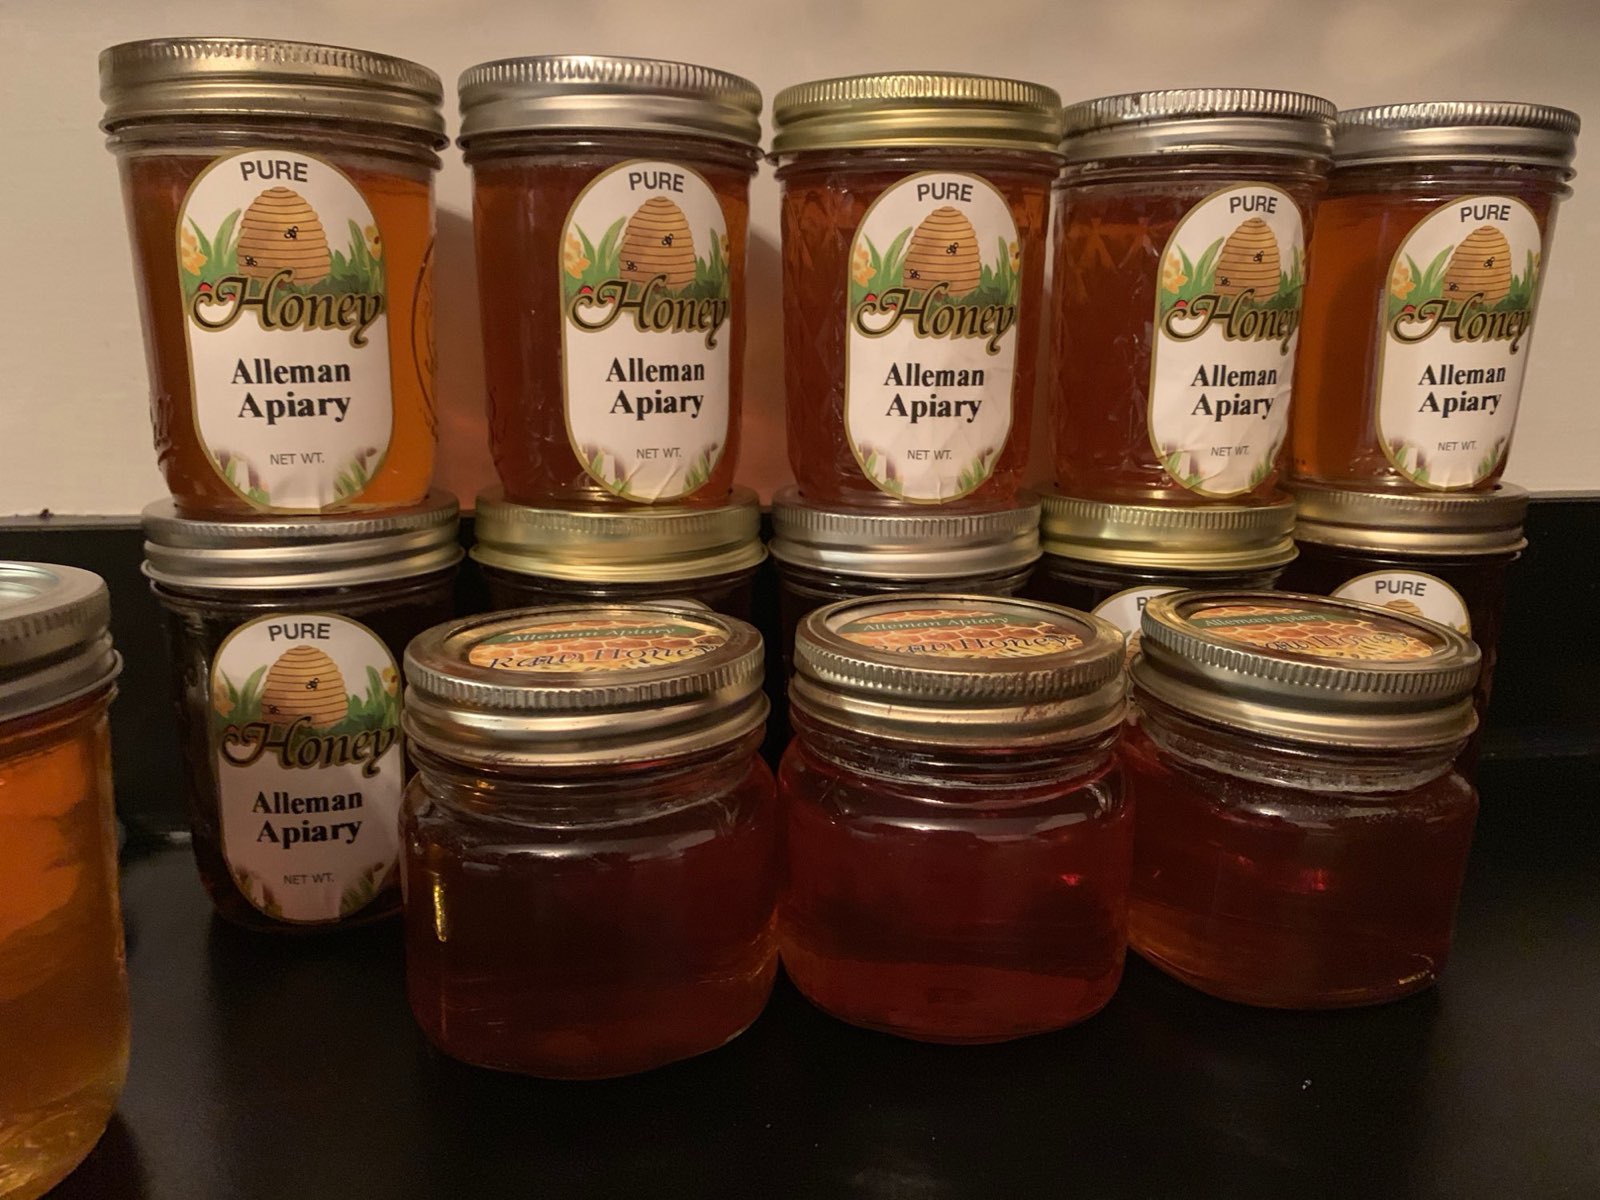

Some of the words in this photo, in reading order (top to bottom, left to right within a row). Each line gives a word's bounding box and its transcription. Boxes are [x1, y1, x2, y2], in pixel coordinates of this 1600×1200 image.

[240, 160, 308, 182] PURE
[628, 172, 684, 193] PURE
[917, 182, 973, 202] PURE
[1230, 195, 1278, 214] PURE
[1460, 204, 1511, 222] PURE
[191, 269, 385, 348] Honey
[570, 274, 729, 349] Honey
[855, 281, 1015, 355] Honey
[1163, 289, 1300, 355] Honey
[1391, 292, 1531, 355] Honey
[231, 358, 351, 384] Alleman
[606, 357, 704, 382] Alleman
[884, 363, 985, 387] Alleman
[1191, 364, 1277, 387] Alleman
[1418, 364, 1506, 386] Alleman
[237, 392, 351, 425] Apiary
[610, 390, 704, 421] Apiary
[885, 393, 982, 424] Apiary
[1191, 393, 1274, 422] Apiary
[1418, 391, 1501, 418] Apiary
[636, 449, 659, 460] NET
[663, 448, 682, 459] WT.
[907, 450, 930, 460] NET
[933, 450, 952, 460] WT.
[1210, 447, 1232, 457] NET
[1235, 445, 1249, 456] WT.
[1438, 442, 1459, 451] NET
[1461, 441, 1477, 450] WT.
[270, 453, 296, 465] NET
[300, 452, 325, 464] WT.
[1375, 580, 1427, 596] PURE
[268, 623, 331, 641] PURE
[863, 619, 941, 632] Alleman
[948, 616, 1009, 627] Apiary
[1205, 617, 1270, 628] Alleman
[1275, 614, 1326, 624] Apiary
[508, 629, 599, 643] Alleman
[607, 626, 676, 638] Apiary
[221, 715, 397, 778] Honey
[252, 791, 363, 815] Alleman
[256, 820, 363, 849] Apiary
[284, 874, 307, 885] NET
[311, 873, 334, 884] WT.
